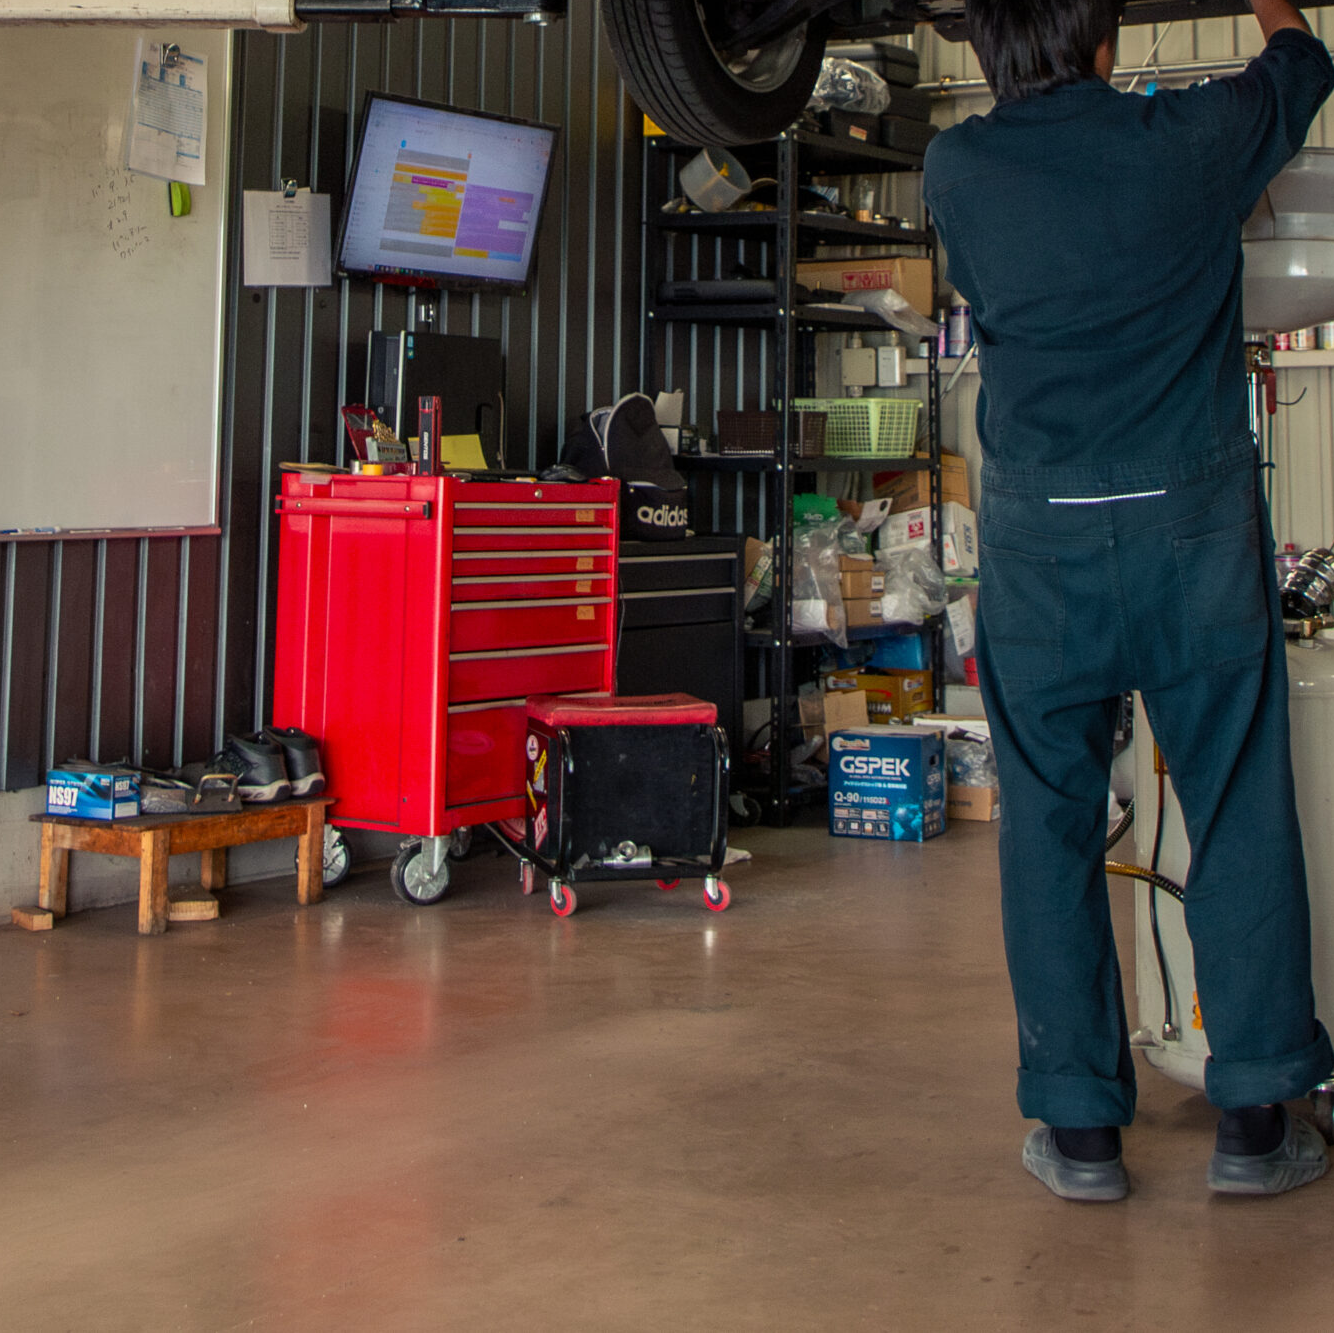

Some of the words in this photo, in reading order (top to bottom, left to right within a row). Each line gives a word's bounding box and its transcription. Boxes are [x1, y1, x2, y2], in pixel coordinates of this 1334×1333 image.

[637, 504, 689, 527] adidas
[840, 755, 911, 777] GSPEK
[48, 785, 79, 807] NS97
[834, 791, 860, 803] Q-90
